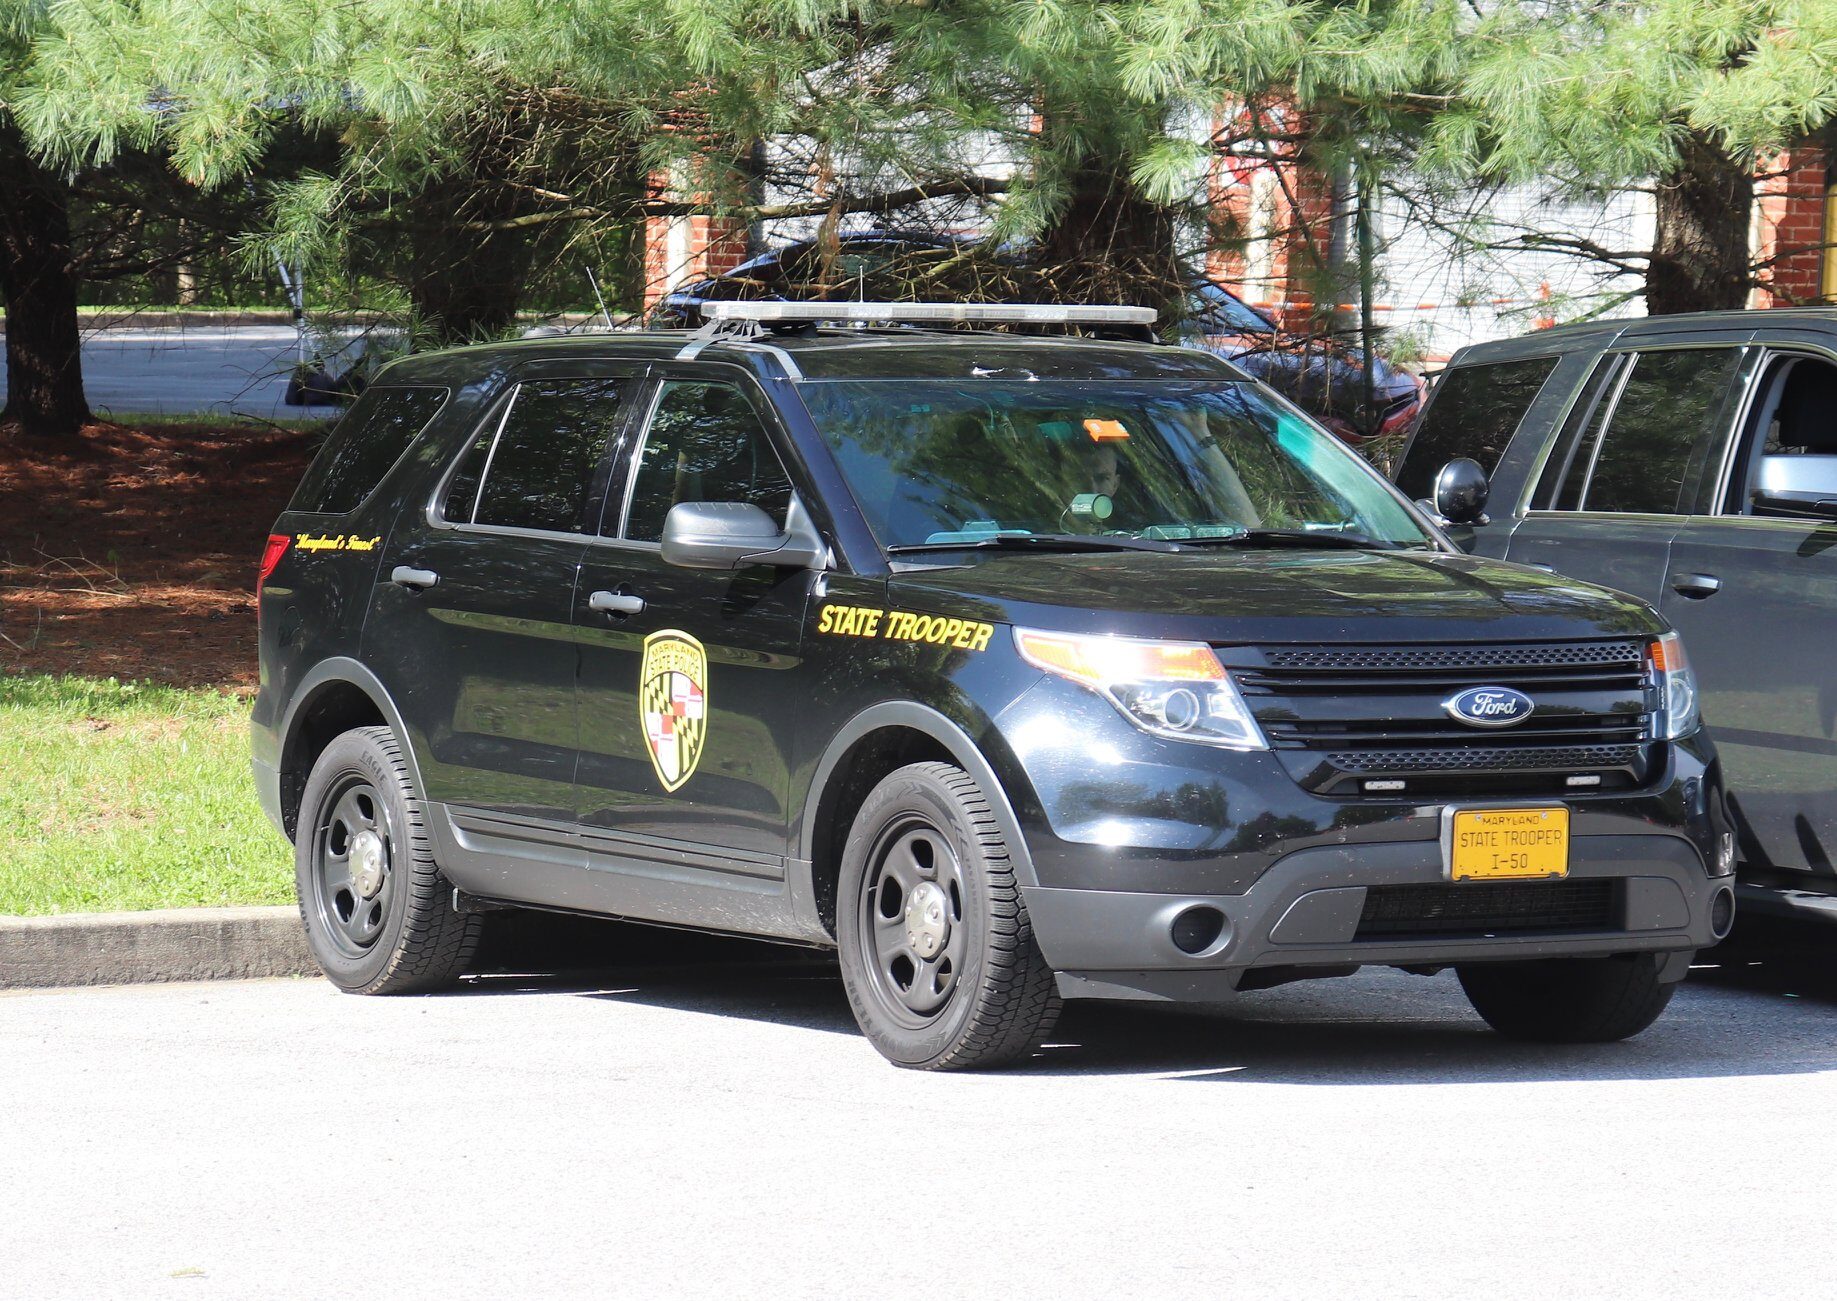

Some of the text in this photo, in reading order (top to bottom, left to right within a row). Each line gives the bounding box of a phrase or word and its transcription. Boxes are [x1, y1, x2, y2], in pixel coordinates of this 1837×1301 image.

[818, 604, 995, 652] STATE TROOPER
[651, 643, 699, 662] MARYLAND
[650, 654, 699, 680] STATE POLICE
[1472, 692, 1517, 716] Ford
[361, 750, 388, 785] EAGLE
[1482, 815, 1540, 826] MARYLAND
[1460, 829, 1562, 848] STATE TROOPER
